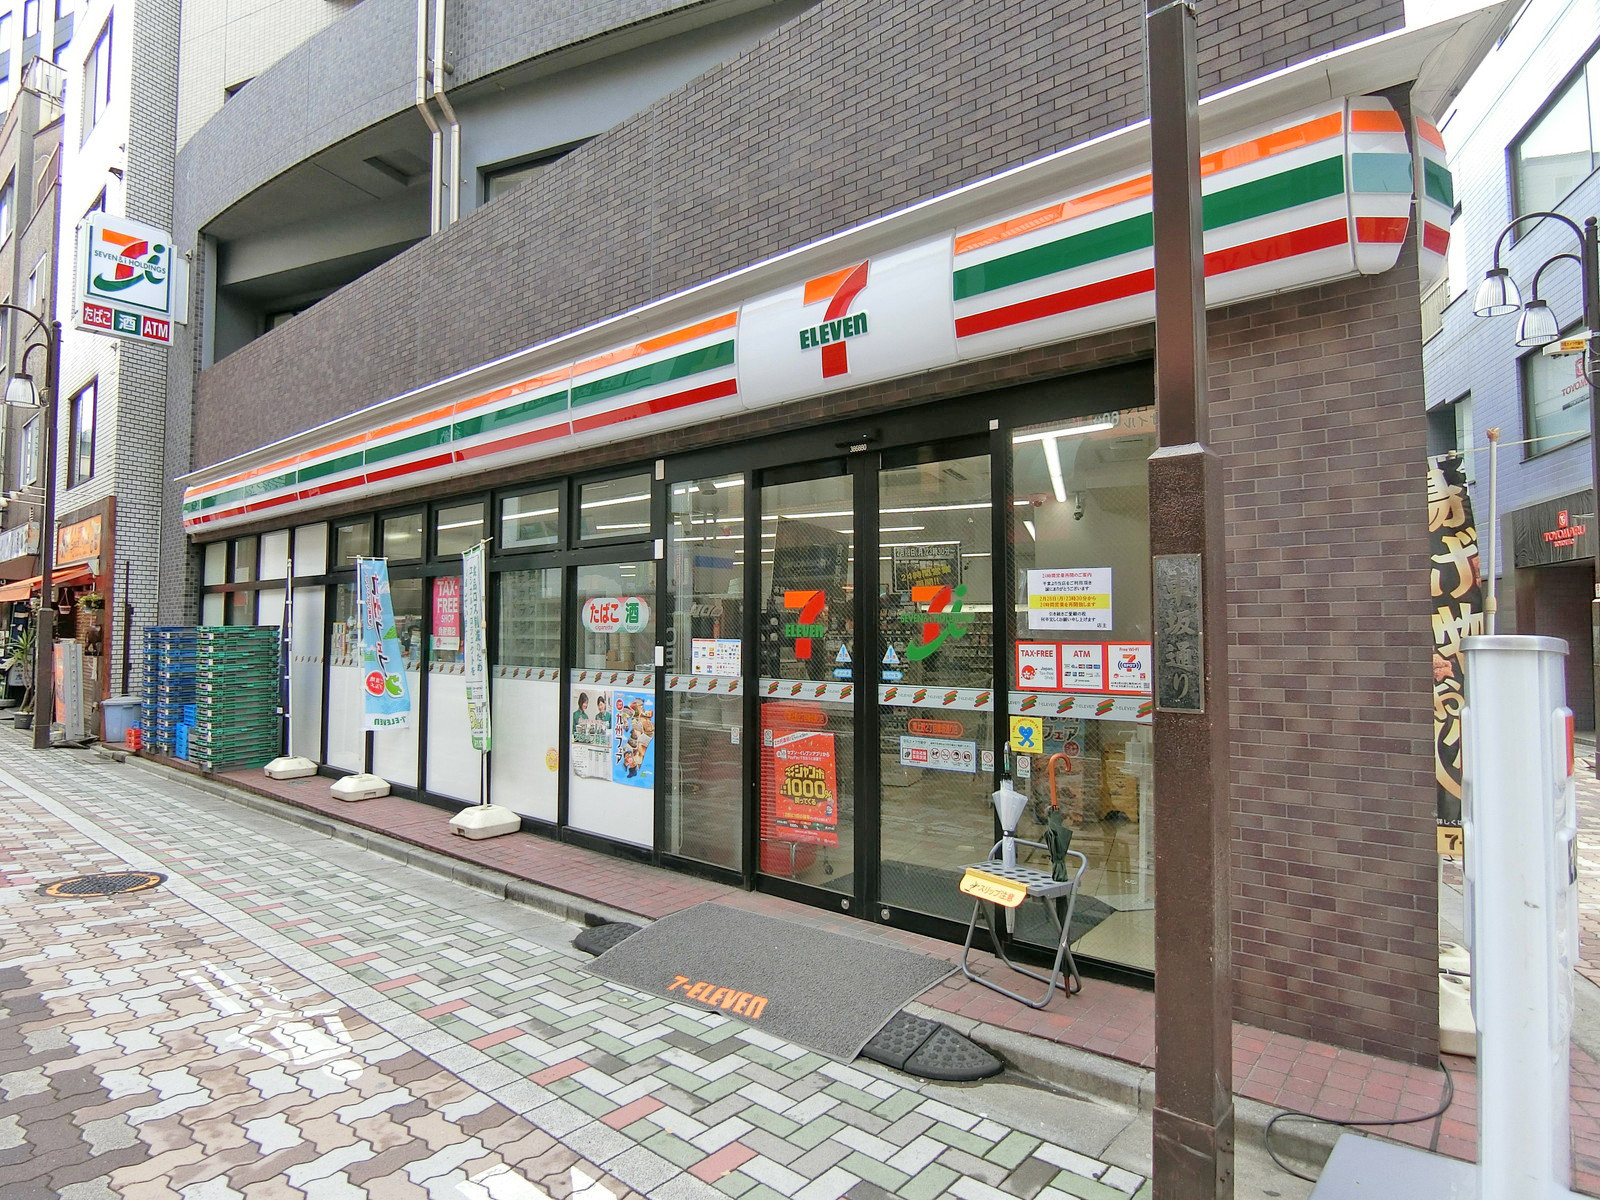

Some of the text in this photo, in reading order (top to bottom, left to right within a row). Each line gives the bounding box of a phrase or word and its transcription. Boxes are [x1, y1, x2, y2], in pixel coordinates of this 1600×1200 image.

[129, 259, 166, 274] HOLDINGS
[84, 306, 111, 326] たばこ
[119, 313, 136, 331] 酒
[144, 320, 168, 338] ATM
[437, 597, 458, 613] FREE
[589, 603, 620, 624] たばこ
[625, 602, 640, 624] 酒
[441, 614, 454, 623] SHOP
[1020, 649, 1053, 658] TAX-FREE
[1073, 650, 1091, 658] ATM
[615, 713, 624, 765] 九州フェア
